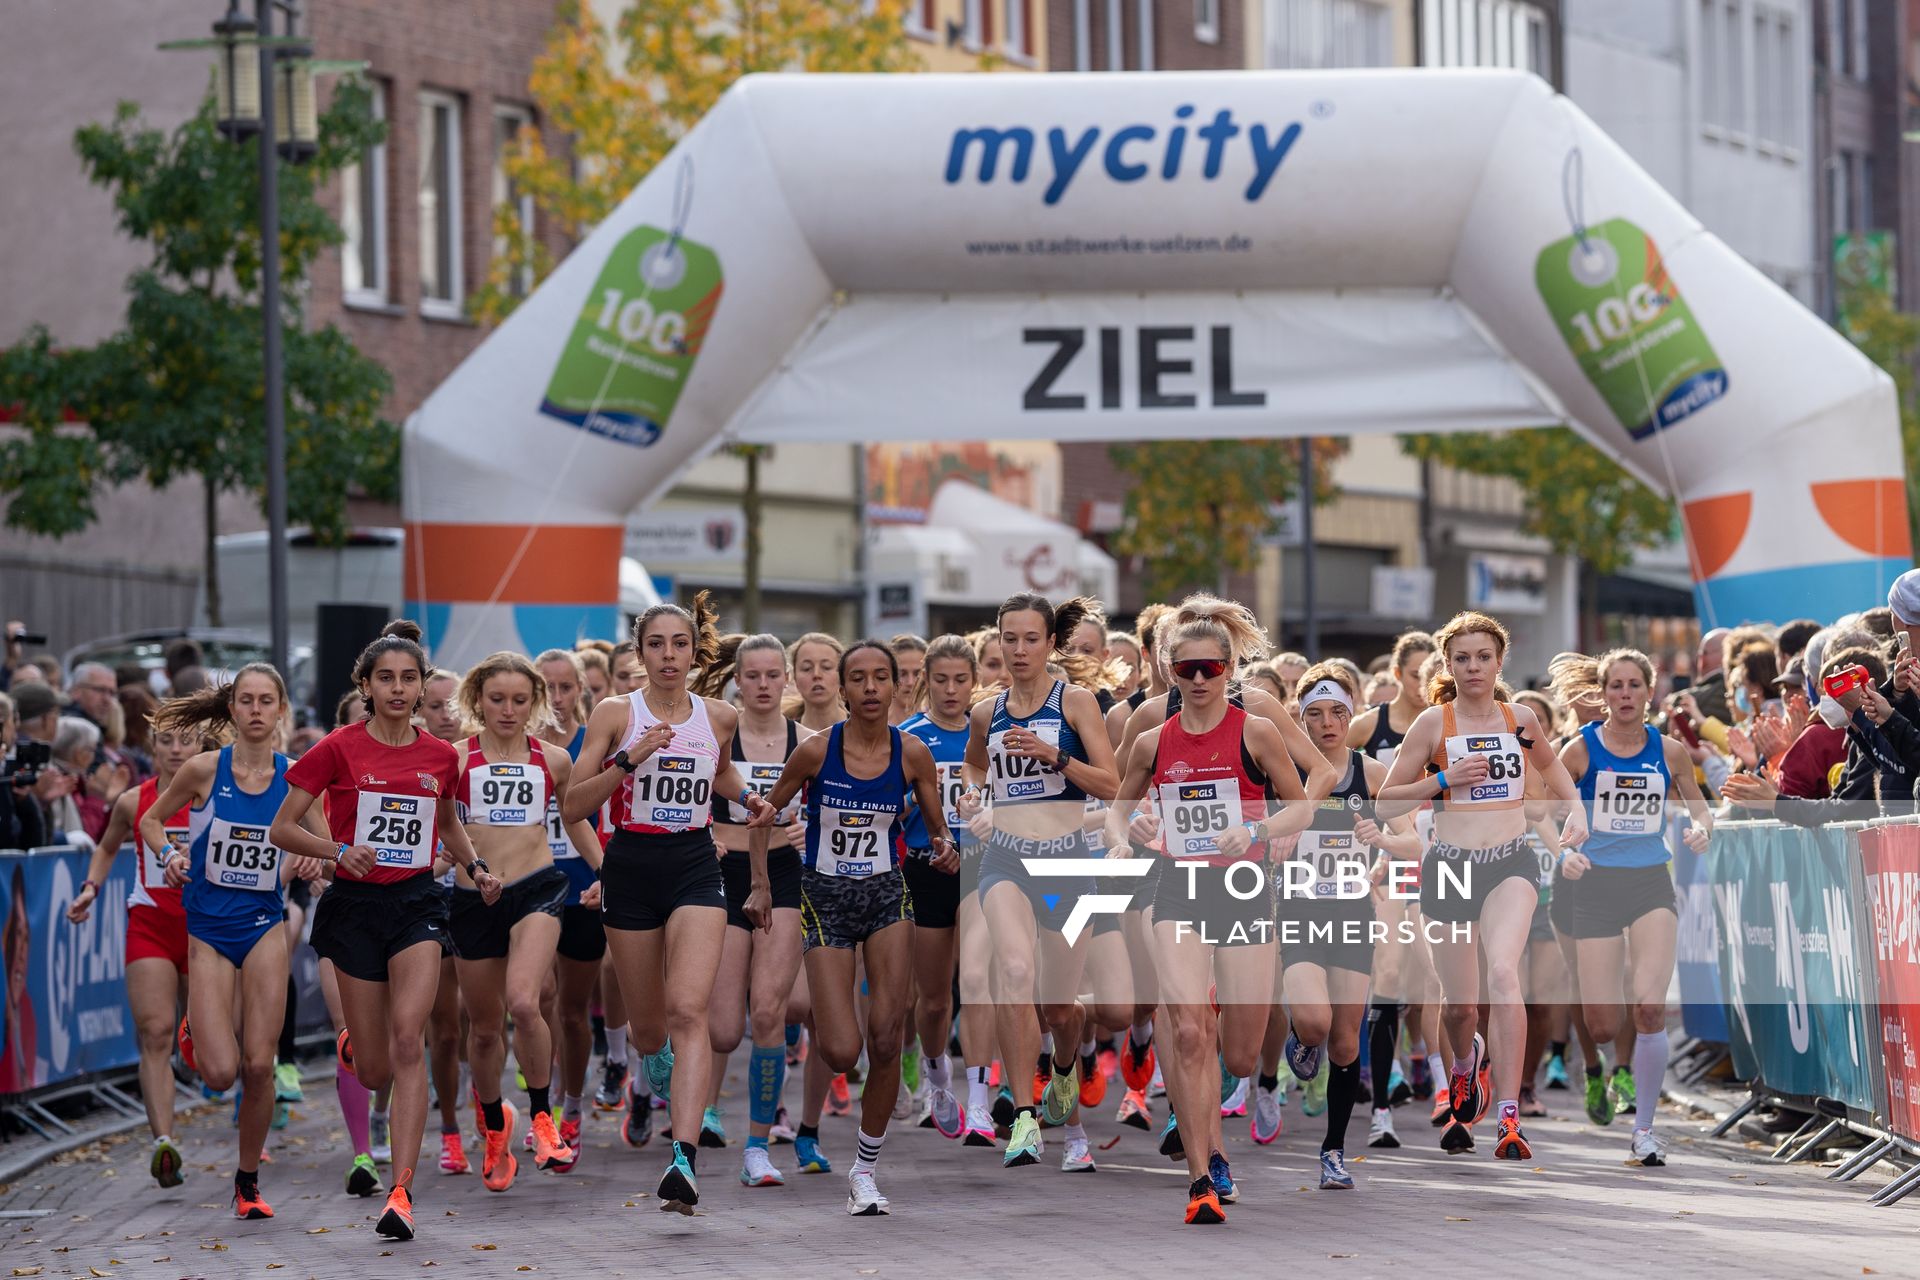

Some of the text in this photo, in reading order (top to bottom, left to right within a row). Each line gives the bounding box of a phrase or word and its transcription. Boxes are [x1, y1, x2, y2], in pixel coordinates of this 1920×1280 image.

[945, 105, 1302, 206] mycity
[1022, 325, 1267, 411] ZIEL
[1485, 740, 1499, 749] GLS
[507, 767, 522, 775] GLS
[677, 762, 692, 770] GLS
[1022, 783, 1043, 791] PLAN
[1632, 779, 1645, 787] GLS
[482, 780, 534, 805] 978
[639, 774, 709, 806] 1080
[1198, 788, 1213, 798] GLS
[1486, 786, 1507, 794] PLAN
[400, 802, 415, 812] GLS
[830, 797, 897, 812] TELIS FINANZ
[1599, 791, 1661, 816] 1028
[669, 810, 690, 819] PLAN
[1174, 803, 1229, 834] 995
[858, 816, 871, 825] GLS
[1625, 820, 1644, 828] PLAN
[248, 830, 263, 841] GLS
[367, 815, 422, 846] 258
[831, 829, 878, 857] 972
[992, 830, 1075, 856] NIKE PRO
[1337, 838, 1350, 847] GLS
[212, 840, 277, 871] 1033
[390, 851, 412, 860] PLAN
[1467, 841, 1513, 864] NIKE
[851, 864, 872, 872] PLAN
[236, 873, 257, 883] PLAN
[78, 878, 126, 986] PLAN
